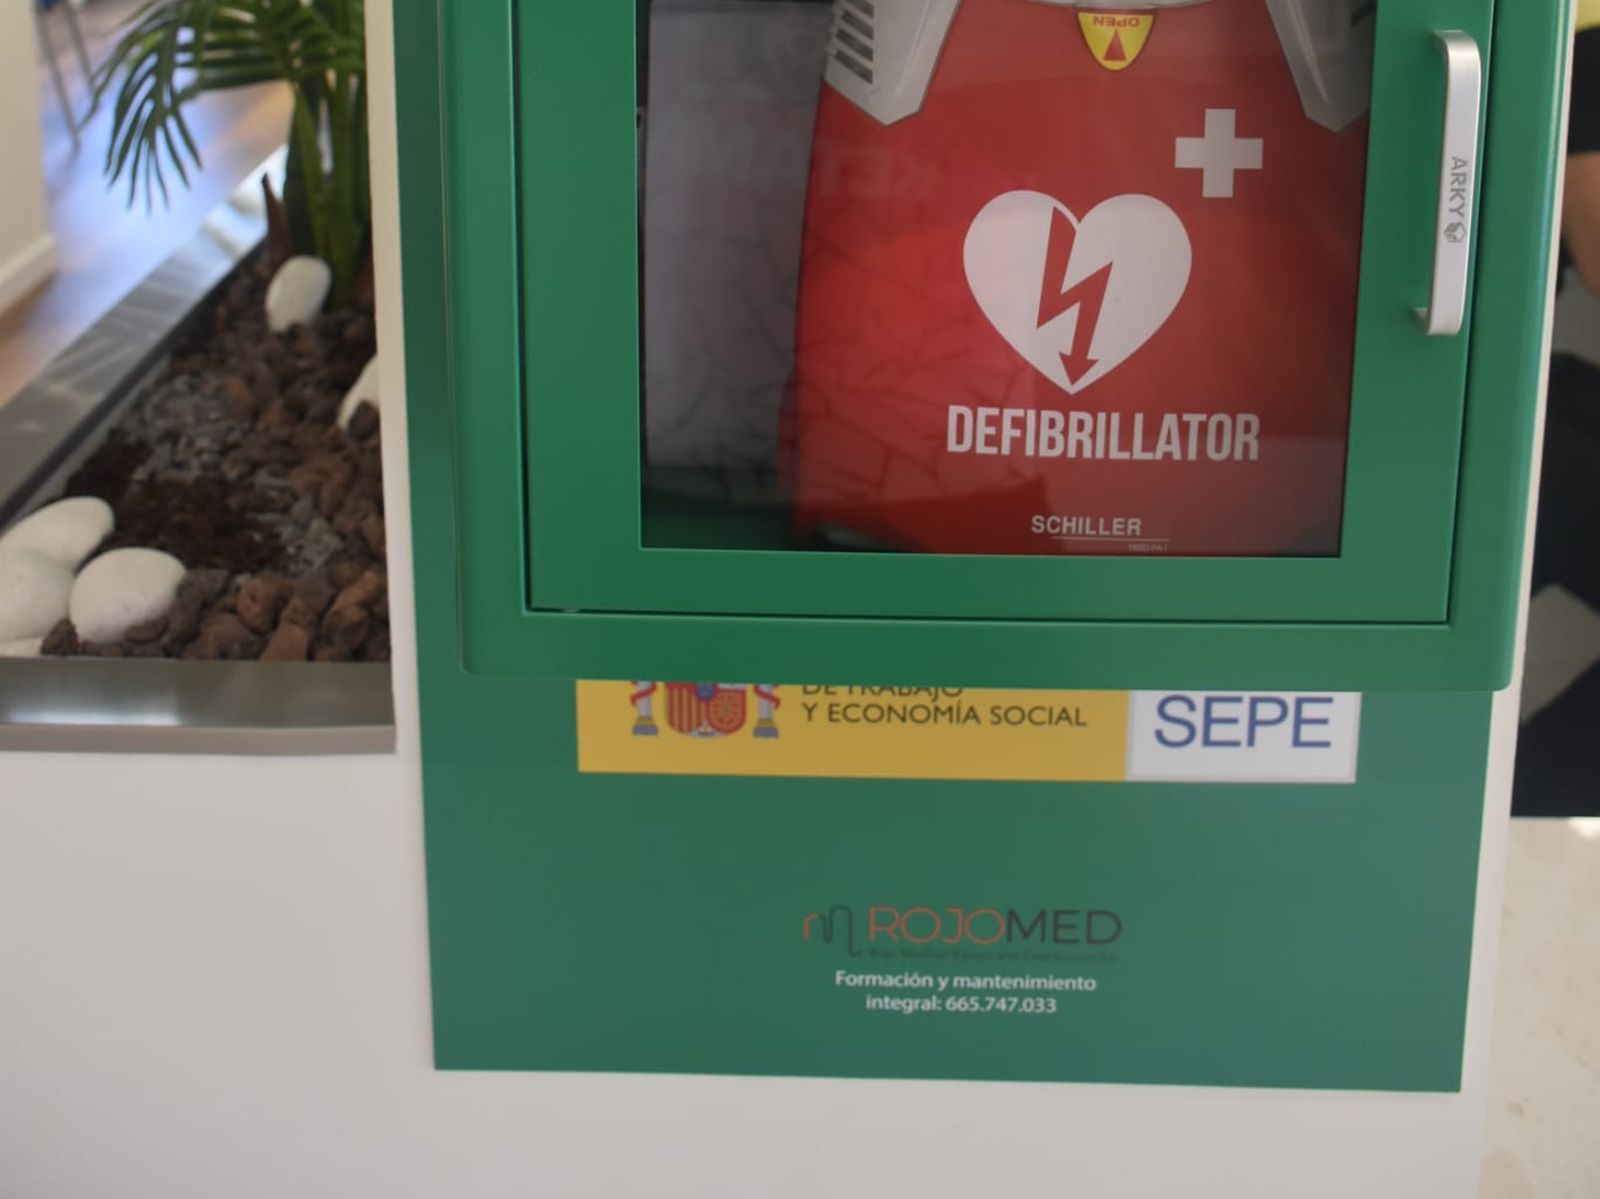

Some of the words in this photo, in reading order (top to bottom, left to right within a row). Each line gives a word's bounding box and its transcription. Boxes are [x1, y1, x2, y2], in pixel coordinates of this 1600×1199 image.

[1093, 15, 1140, 28] OPEN
[1448, 156, 1468, 219] ARKY
[947, 404, 1261, 461] DEFIBRILLATOR
[1031, 515, 1142, 536] SCHILLER
[801, 702, 818, 722] Y
[827, 700, 982, 725] ECONOMÍA
[989, 705, 1087, 727] SOCIAL
[1153, 695, 1334, 749] SEPE
[868, 904, 1123, 945] ROJOMED
[835, 969, 934, 988] Formación
[937, 976, 950, 992] y
[952, 973, 1097, 992] mantenimiento
[866, 994, 943, 1015] integral:
[945, 995, 1058, 1014] 665.747.033
